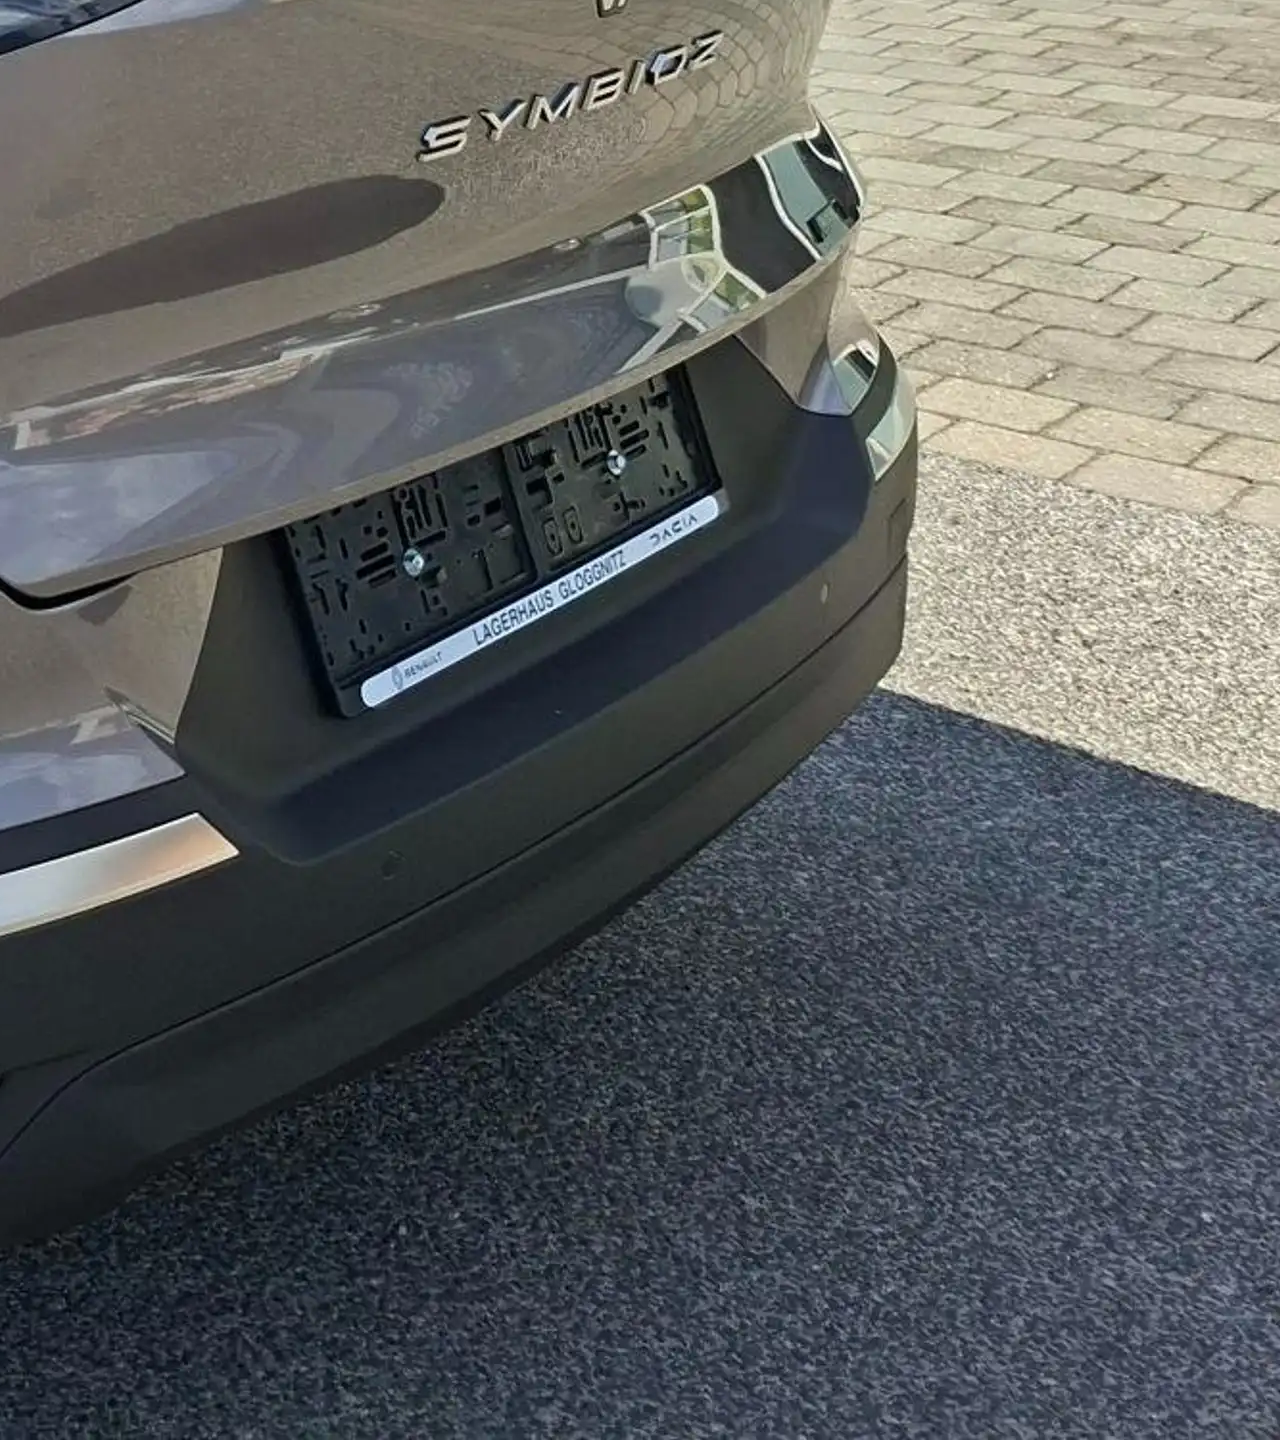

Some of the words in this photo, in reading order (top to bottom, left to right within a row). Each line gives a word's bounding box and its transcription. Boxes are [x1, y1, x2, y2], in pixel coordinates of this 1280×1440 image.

[416, 29, 724, 161] SYMBIOZ
[472, 590, 554, 646] LAGERHAUS
[558, 549, 626, 601] GLOGGNITZ
